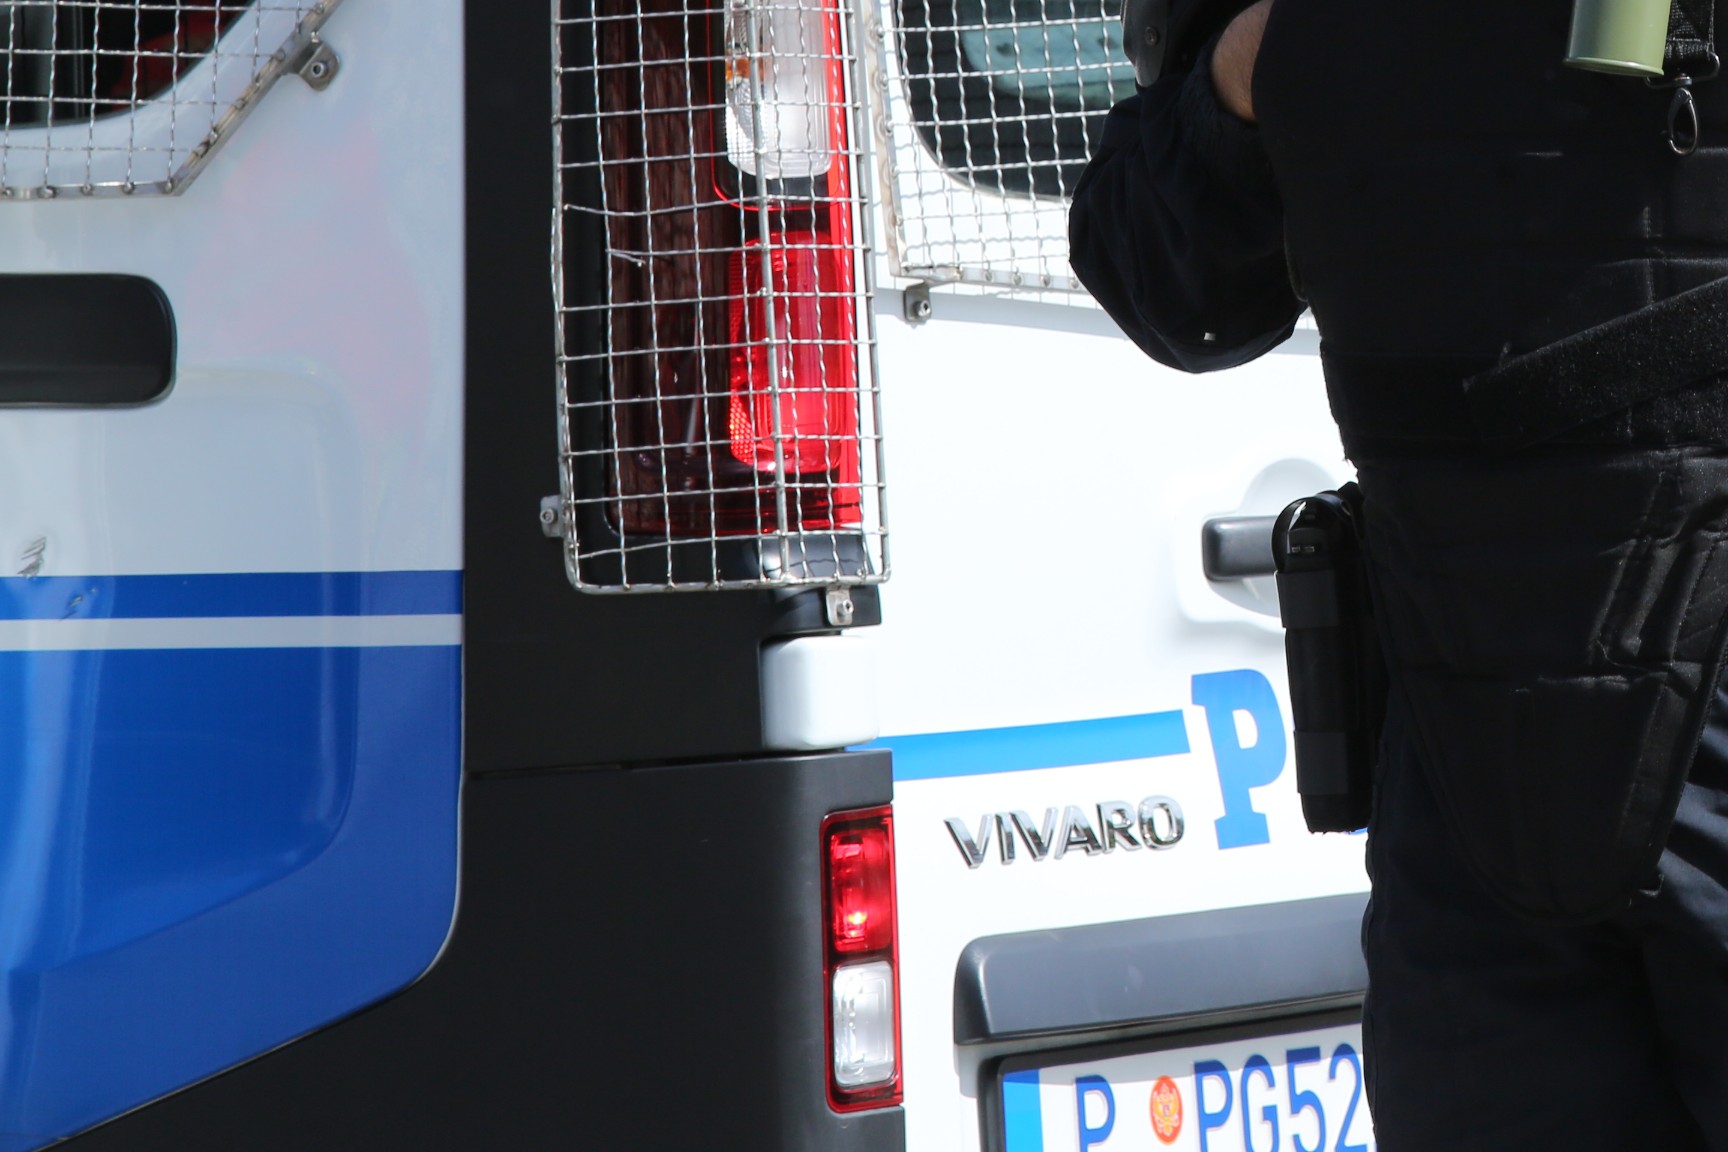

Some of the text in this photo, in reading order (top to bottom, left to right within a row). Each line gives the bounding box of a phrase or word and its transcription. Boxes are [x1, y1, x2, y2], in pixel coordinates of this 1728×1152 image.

[943, 795, 1185, 868] VIVARO
[1075, 1043, 1368, 1152] P PG52
